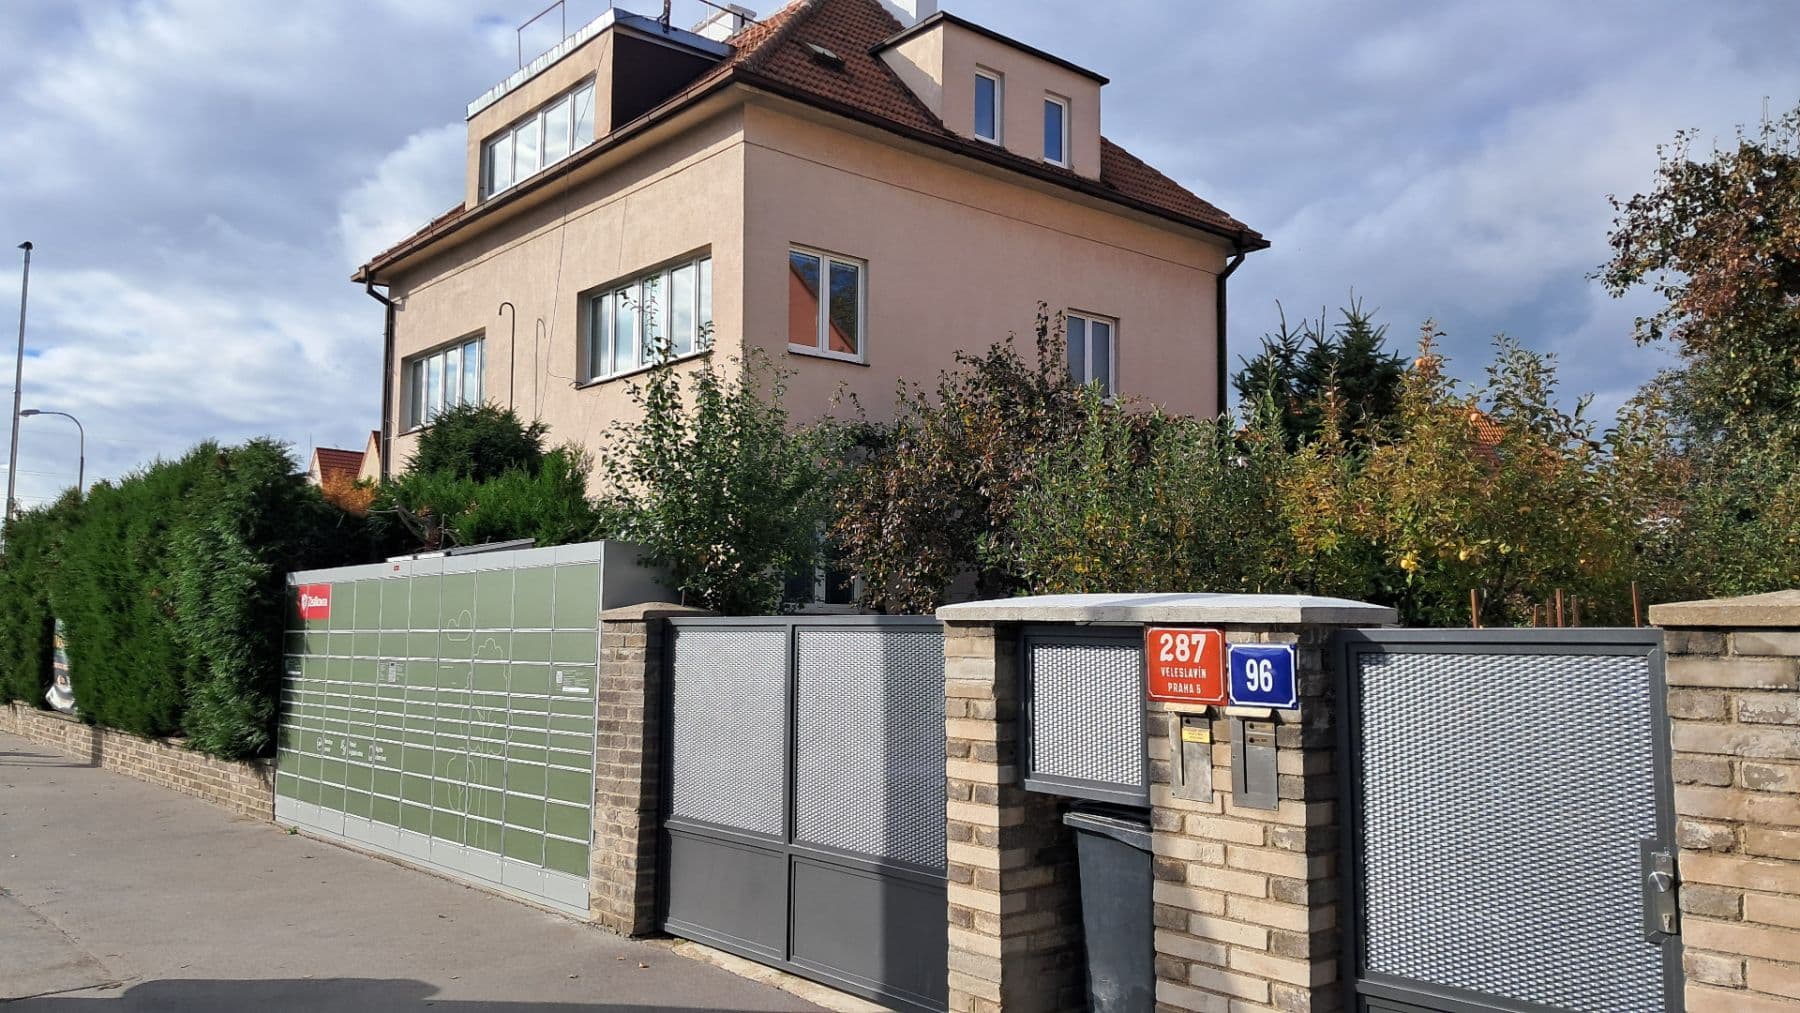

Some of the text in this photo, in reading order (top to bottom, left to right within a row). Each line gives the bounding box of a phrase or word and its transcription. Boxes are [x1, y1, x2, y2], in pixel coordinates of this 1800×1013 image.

[1160, 633, 1206, 663] 287
[1160, 666, 1206, 679] VELESLAVÍN
[1245, 658, 1273, 692] 96
[1167, 682, 1194, 694] PRAHA
